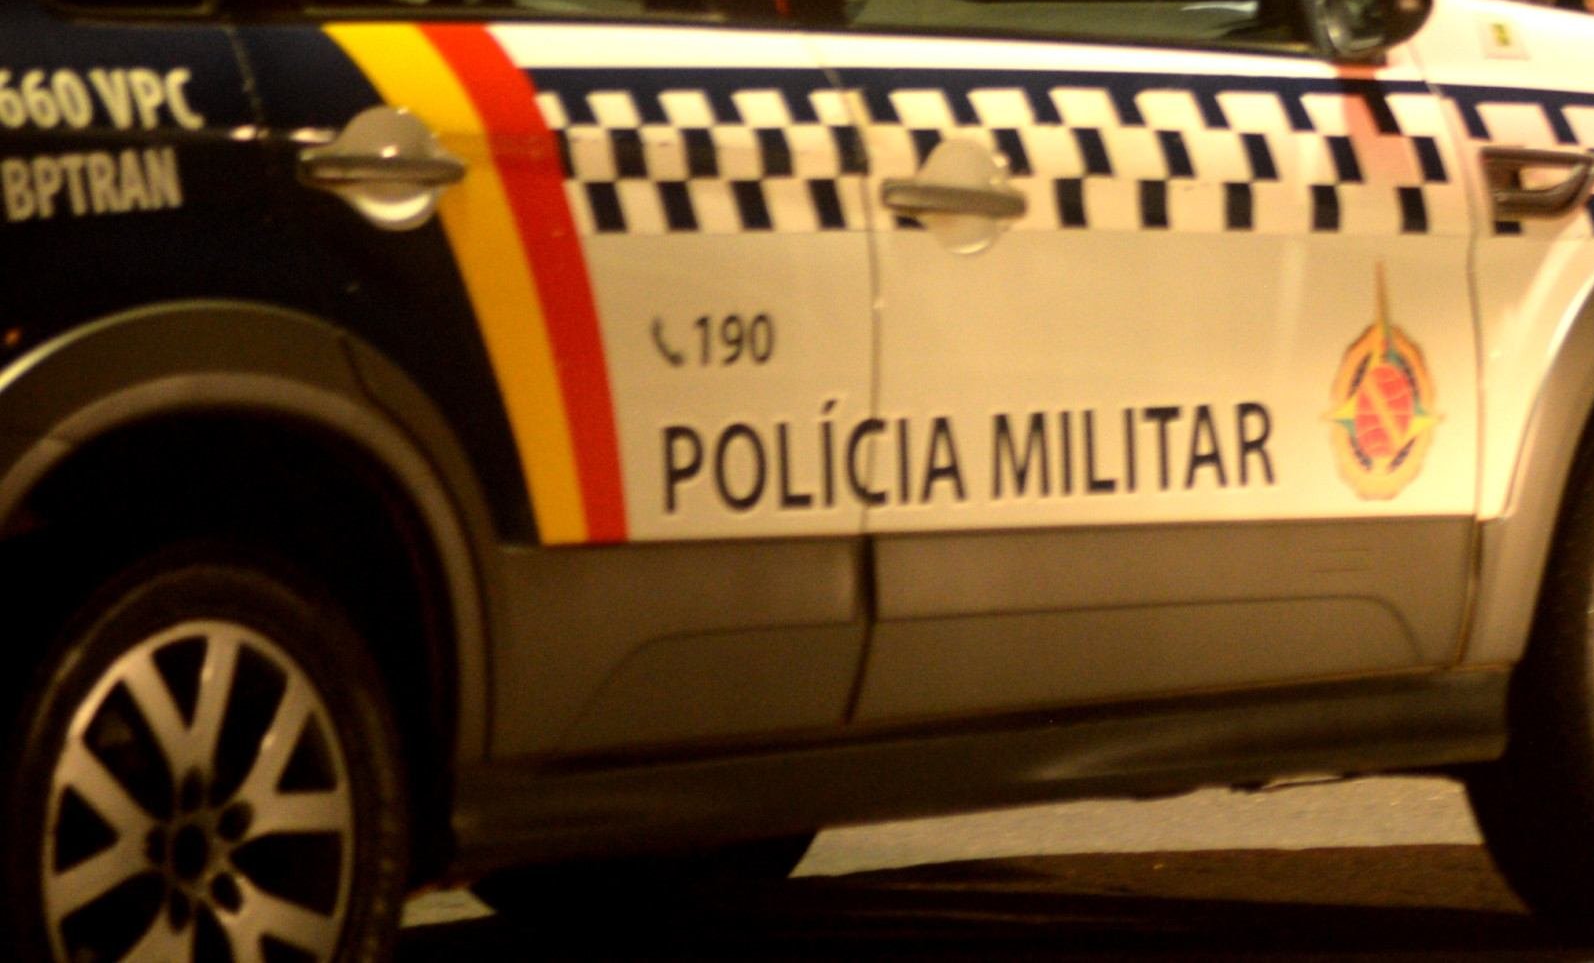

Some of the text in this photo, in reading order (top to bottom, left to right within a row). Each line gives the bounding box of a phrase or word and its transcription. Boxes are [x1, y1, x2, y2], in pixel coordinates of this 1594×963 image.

[0, 66, 206, 130] 660 VPC
[1, 147, 183, 223] BPTRAN
[694, 314, 775, 366] 190
[662, 398, 1277, 514] POLÍCIA MILITAR
